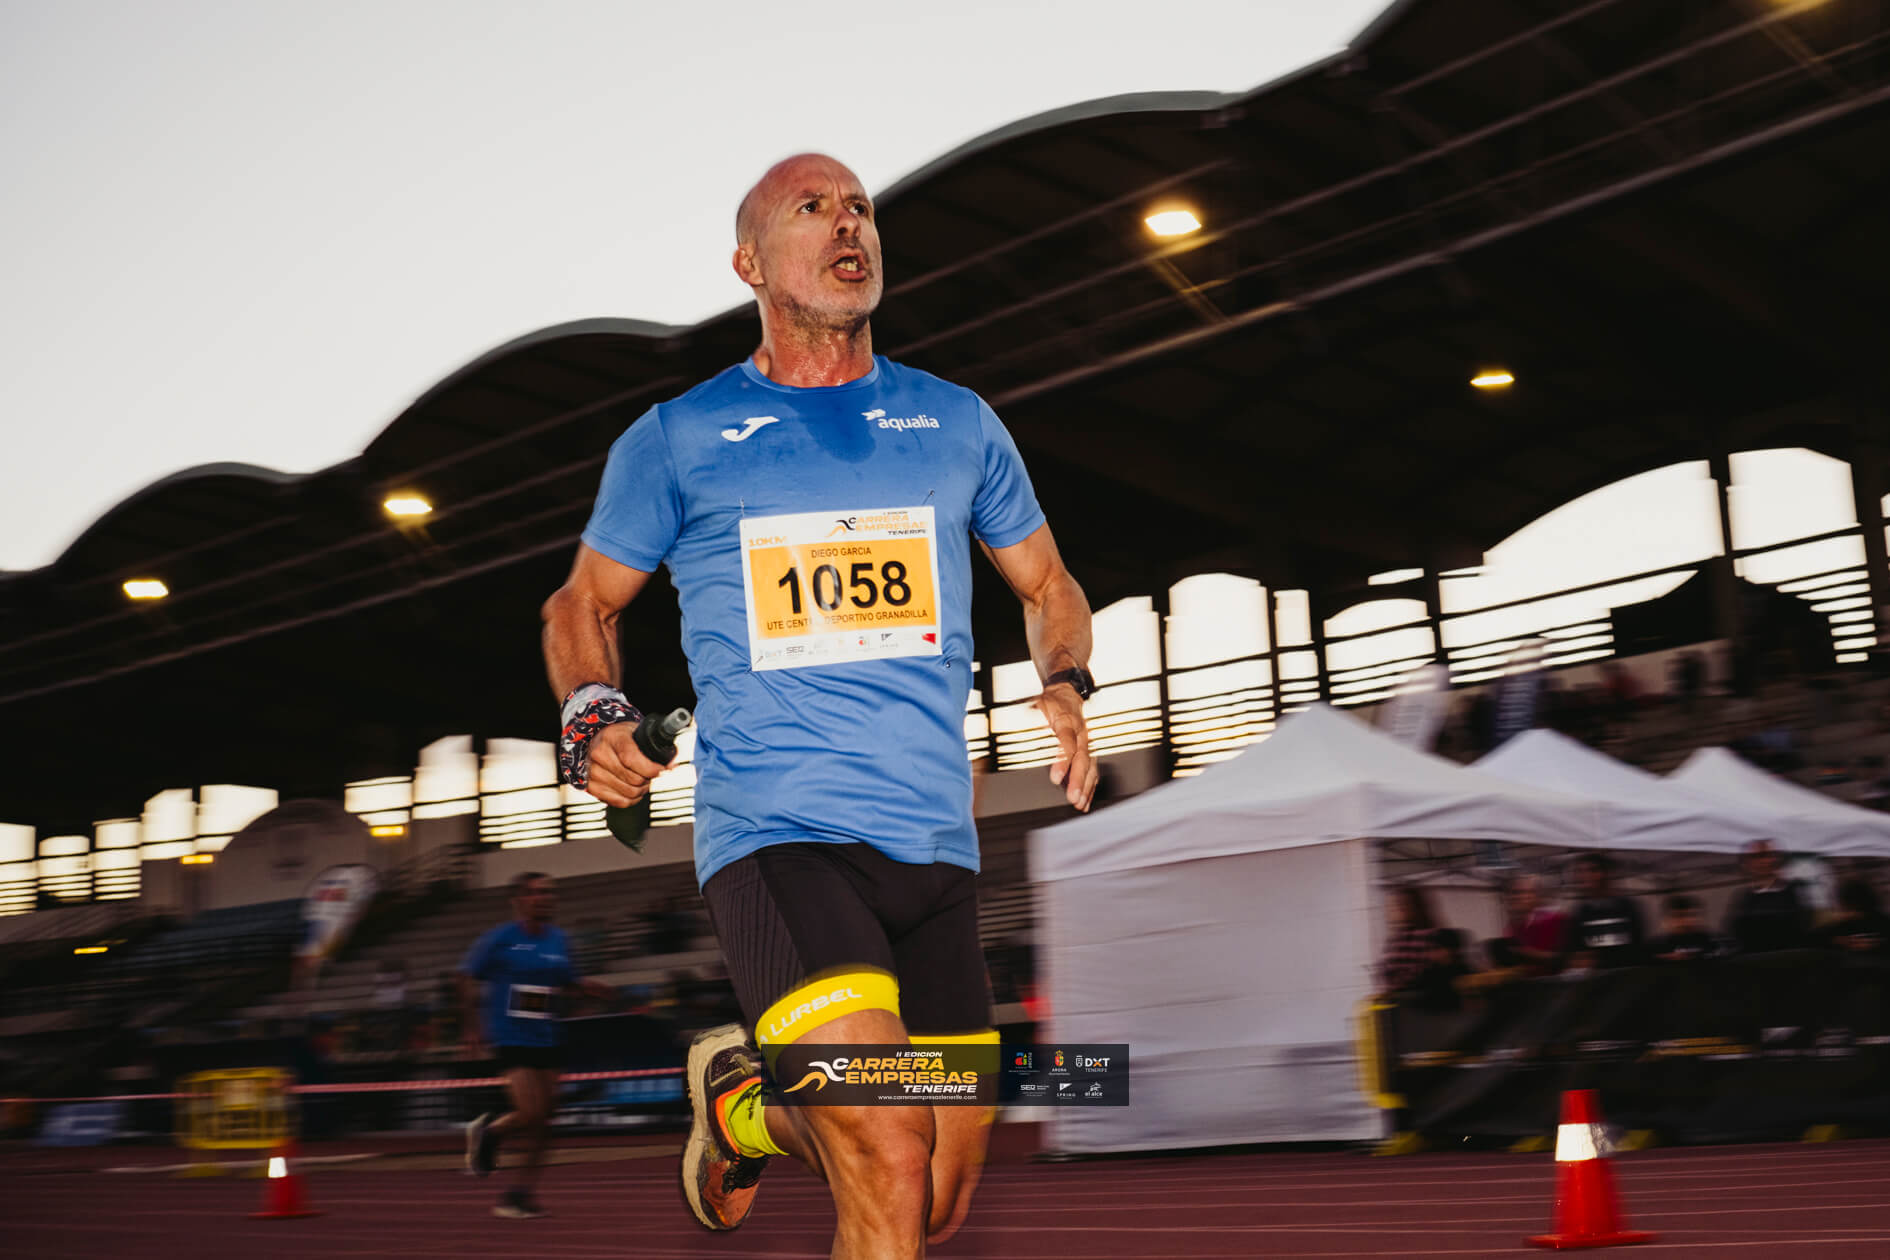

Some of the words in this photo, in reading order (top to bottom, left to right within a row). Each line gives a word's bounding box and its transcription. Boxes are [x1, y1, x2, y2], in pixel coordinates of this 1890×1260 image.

[878, 413, 940, 432] aqualia
[811, 549, 838, 558] DIEGO
[840, 547, 872, 556] GARCIA
[778, 560, 912, 615] 1058
[767, 621, 784, 631] UTE
[875, 609, 927, 620] GRANADILLA
[770, 988, 863, 1036] LURBEL
